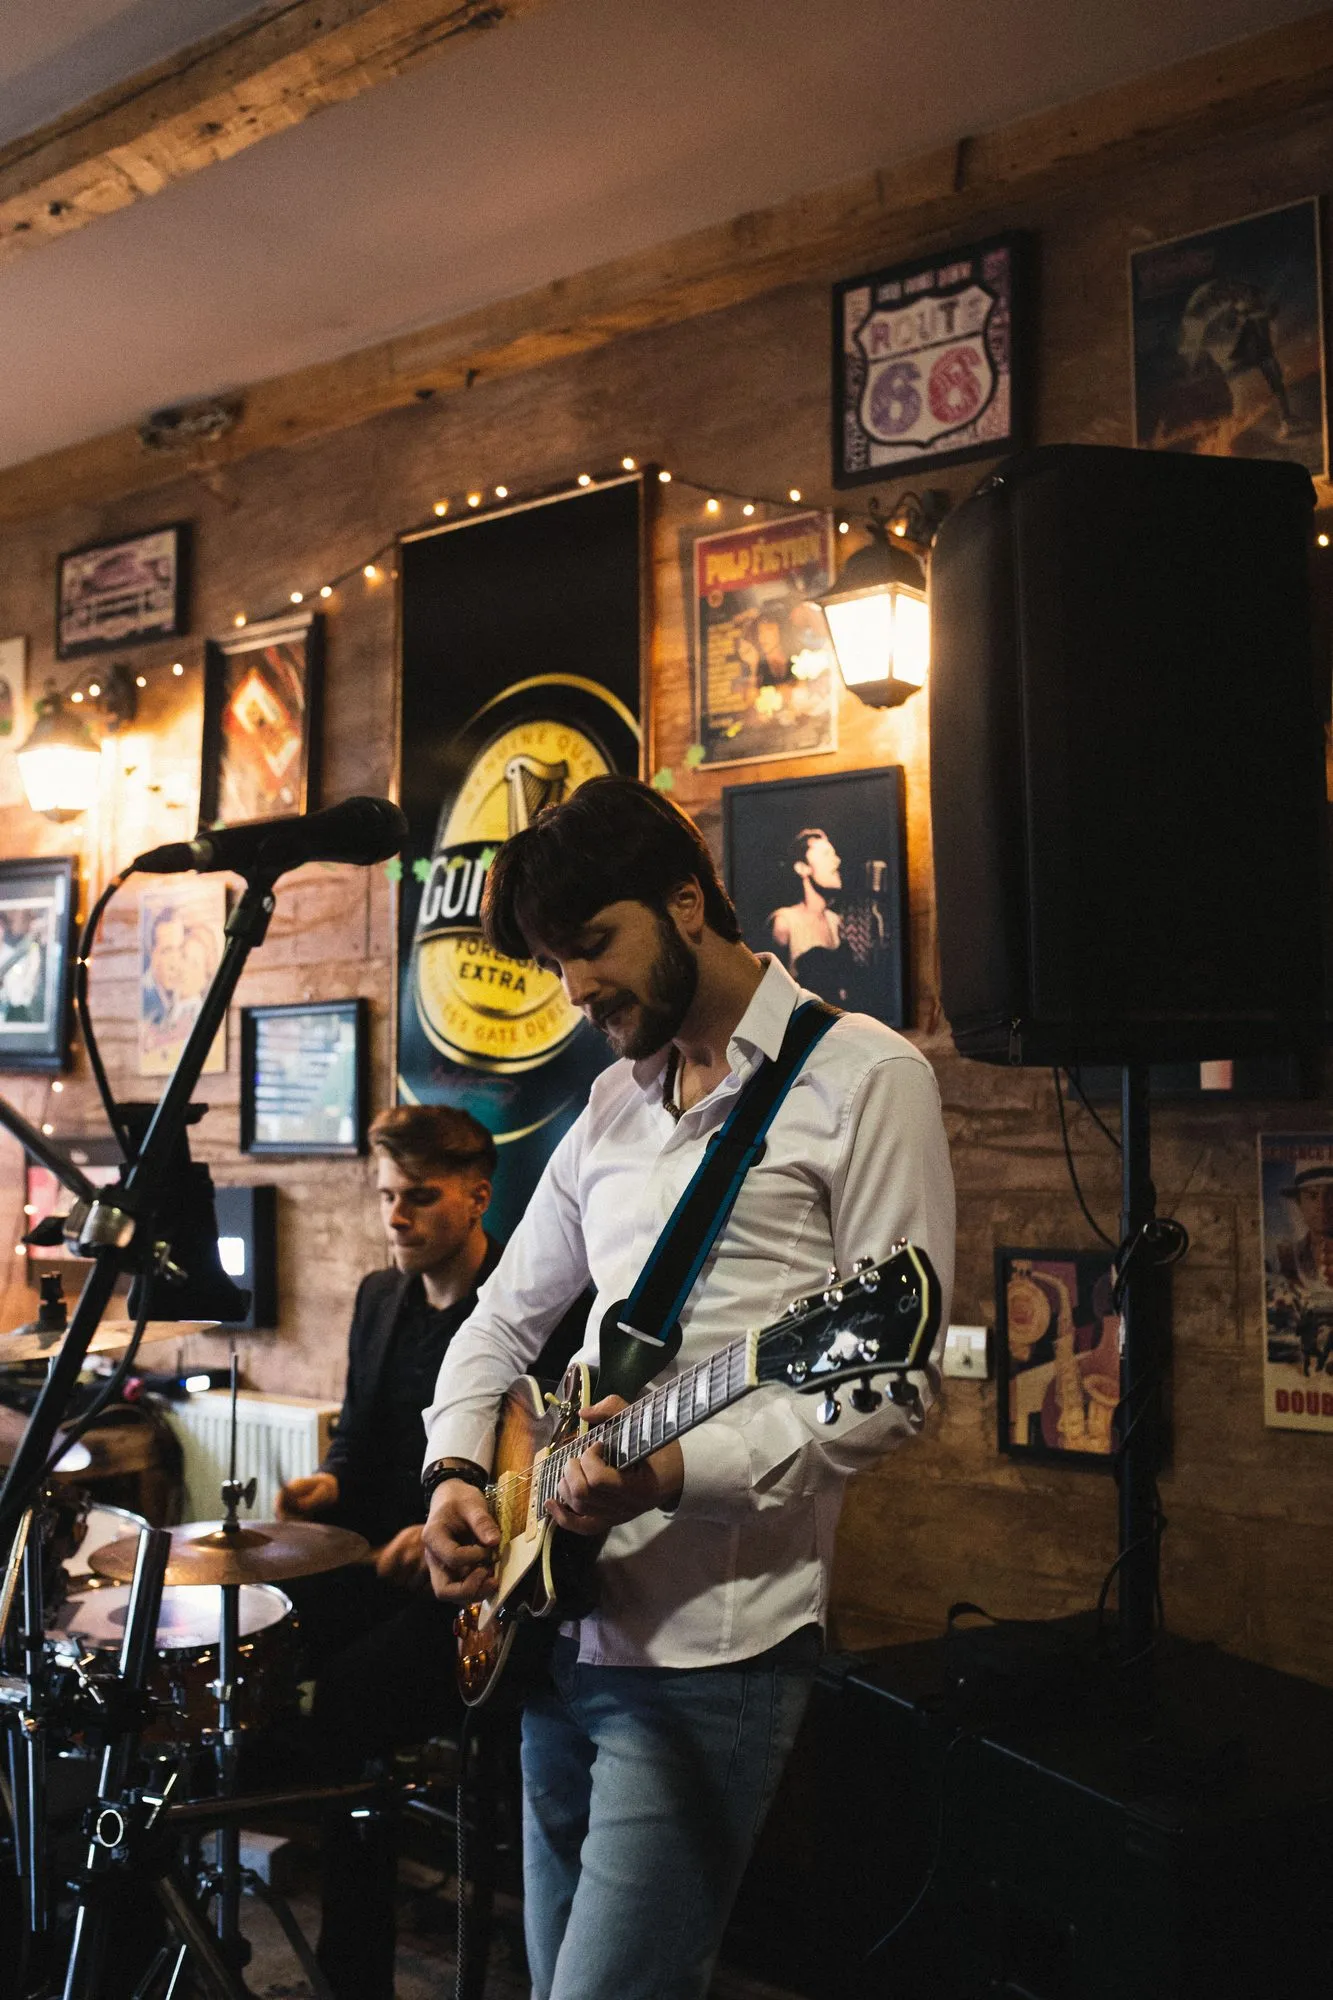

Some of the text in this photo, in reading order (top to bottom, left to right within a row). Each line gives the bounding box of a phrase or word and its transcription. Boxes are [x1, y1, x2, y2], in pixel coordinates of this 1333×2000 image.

[869, 294, 983, 355] ROUTE
[870, 345, 983, 437] 66
[459, 961, 526, 995] EXTRA
